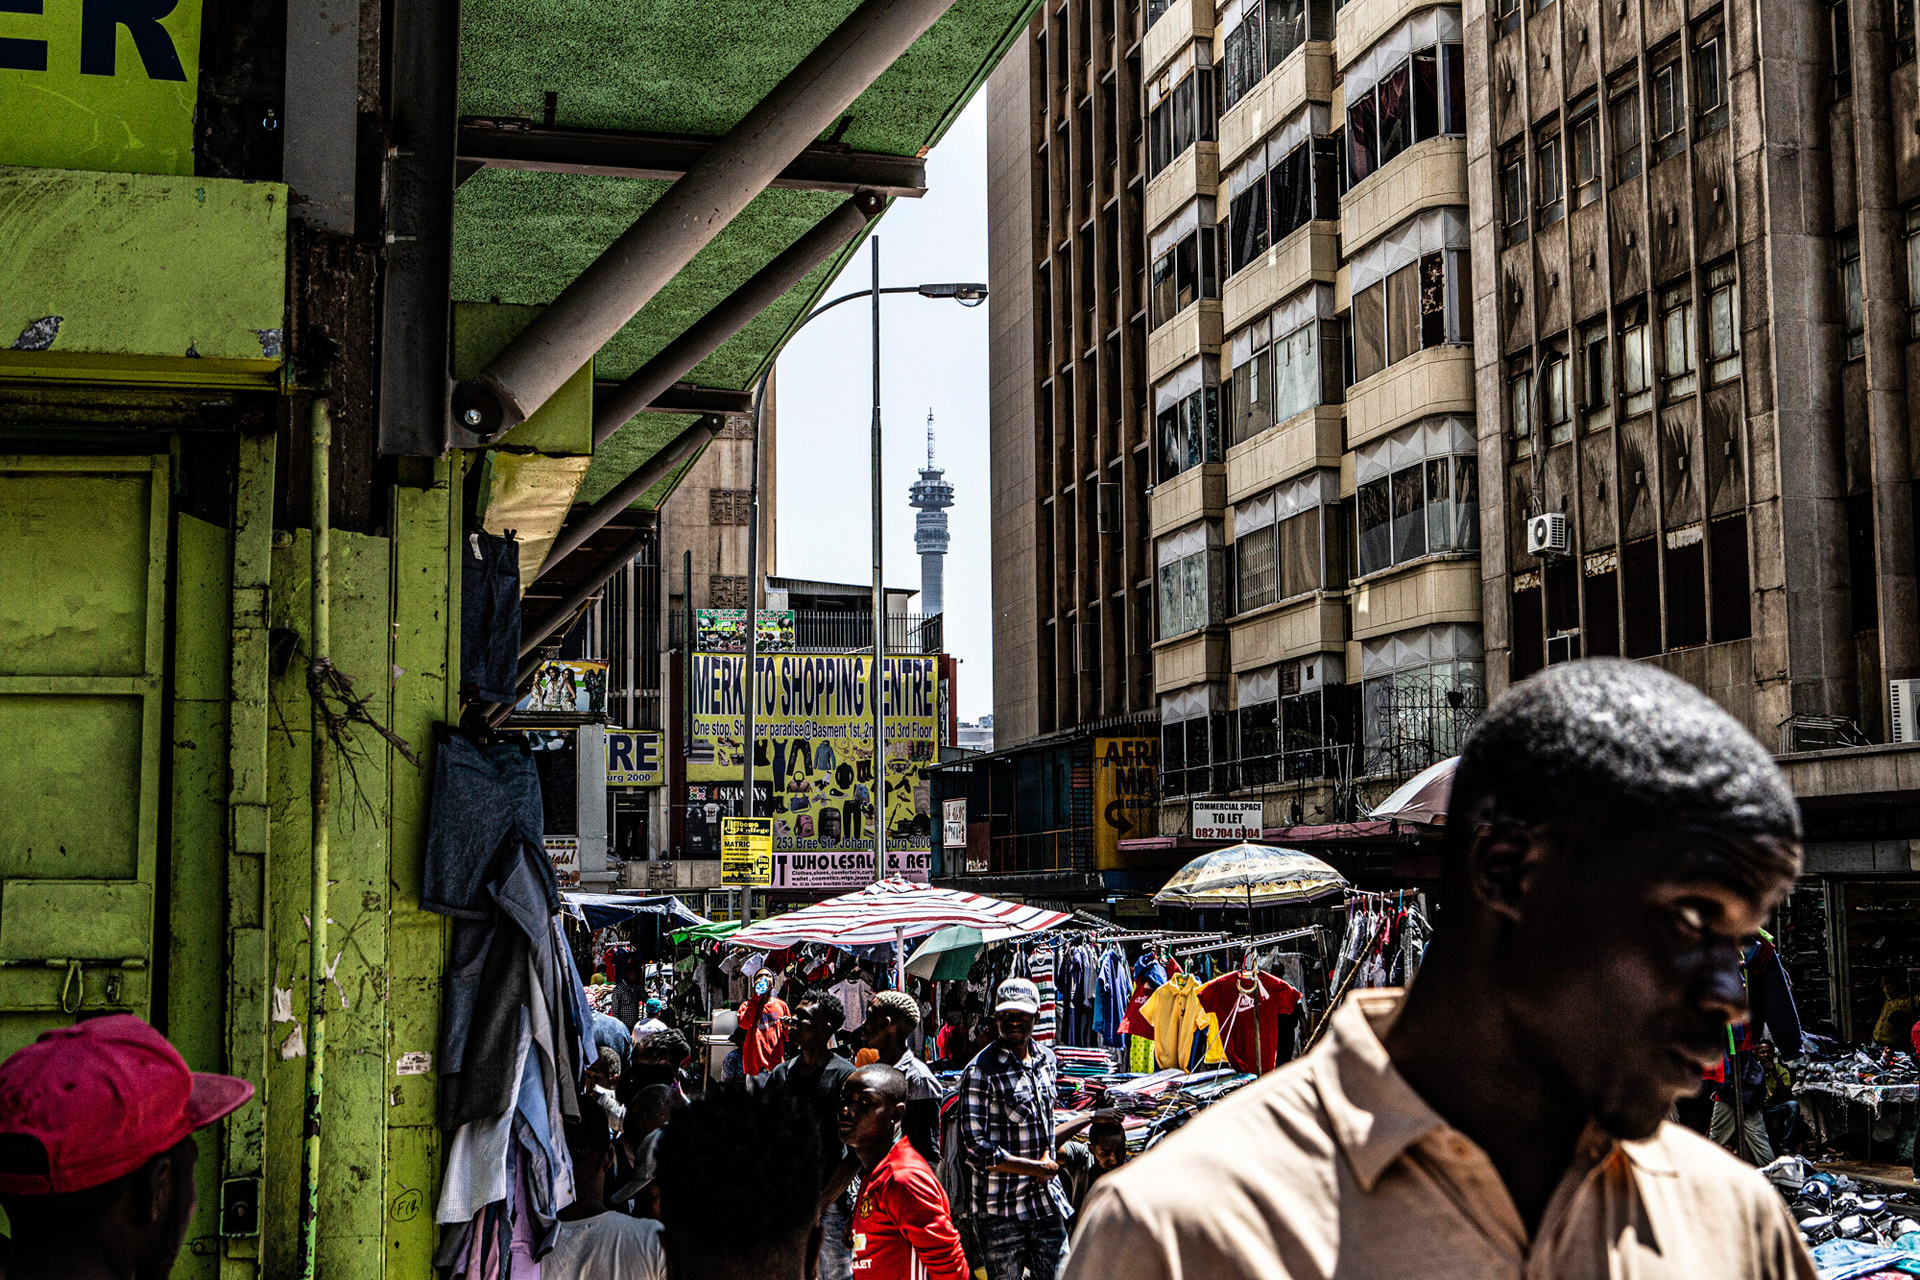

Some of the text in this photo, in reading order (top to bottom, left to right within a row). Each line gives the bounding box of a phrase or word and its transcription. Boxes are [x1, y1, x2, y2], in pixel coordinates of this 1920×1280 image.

[693, 656, 776, 717] MERKTO
[781, 656, 864, 718] SHOPPING
[693, 719, 710, 736] One
[711, 720, 732, 740] stop,
[897, 721, 910, 738] 3rd
[912, 721, 933, 738] Floor
[626, 773, 651, 782] 2000
[708, 787, 767, 801] 4 SEASNS
[1194, 802, 1262, 811] COMMERCIAL SPACE
[1212, 813, 1243, 824] TO LET
[1195, 827, 1260, 838] 082 704 604
[776, 835, 931, 852] 253 Bree Str. Johannburg 2000
[792, 854, 876, 870] WHOLESAL
[888, 854, 900, 868] &
